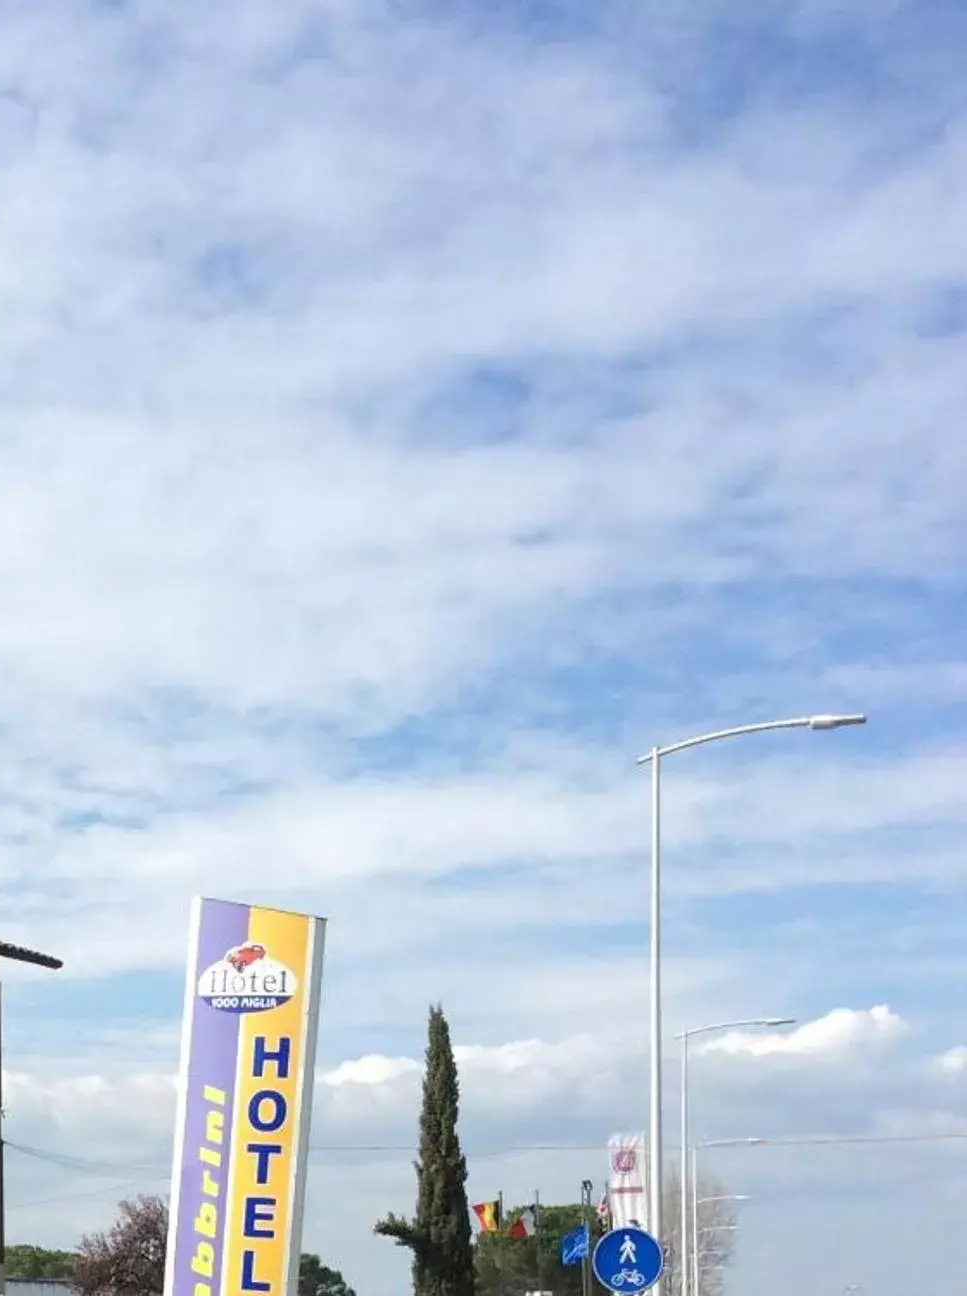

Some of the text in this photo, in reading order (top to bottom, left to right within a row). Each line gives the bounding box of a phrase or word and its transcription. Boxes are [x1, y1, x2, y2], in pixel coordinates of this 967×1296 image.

[210, 969, 287, 993] Hotel
[211, 997, 277, 1009] 1000 MIGLIA
[240, 1036, 291, 1292] HOTEL
